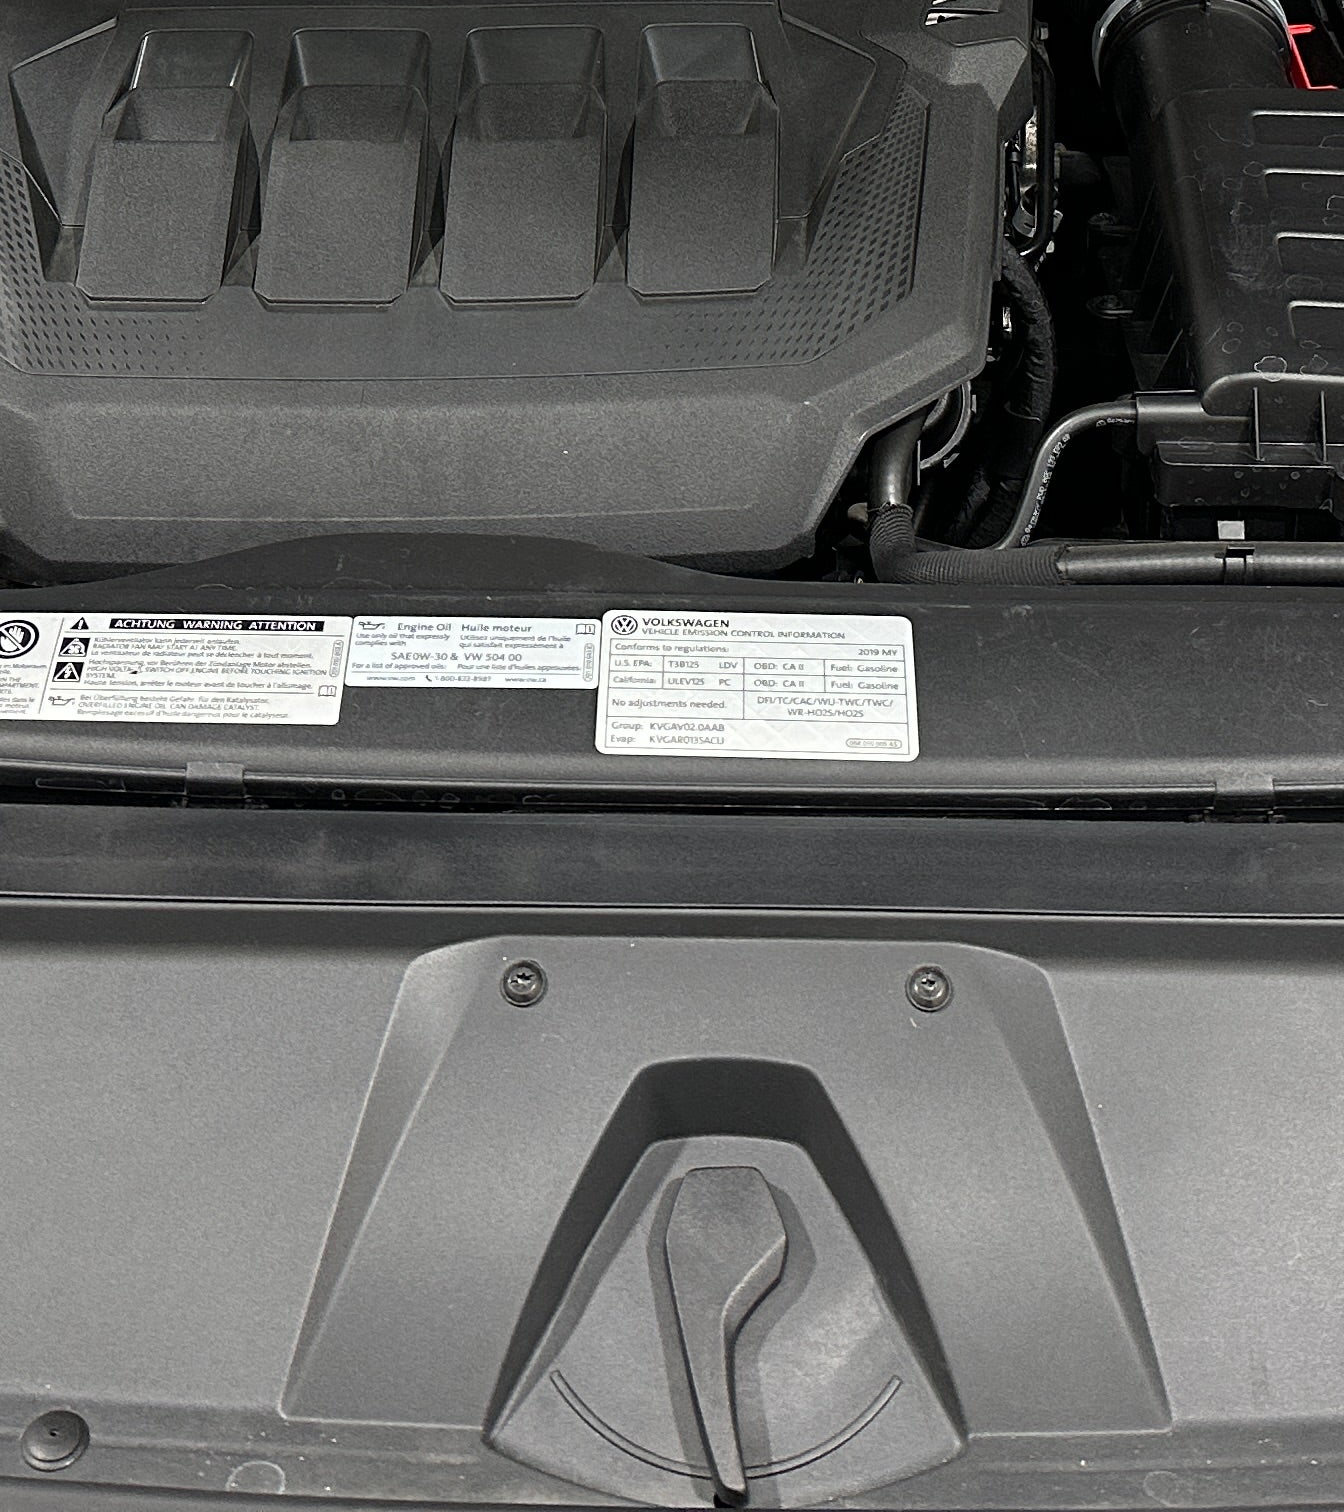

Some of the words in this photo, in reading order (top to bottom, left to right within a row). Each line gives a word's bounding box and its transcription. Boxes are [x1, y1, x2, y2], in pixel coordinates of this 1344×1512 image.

[114, 619, 176, 629] ACHTUNG
[182, 620, 243, 630] WARNING
[249, 621, 317, 631] ATTENTION
[397, 622, 434, 633] Engine
[436, 623, 452, 632] Oil
[461, 623, 490, 632] Huile
[492, 624, 533, 633] moteur
[641, 617, 730, 628] VOLKSWAGEN
[641, 628, 680, 636] VEHICLE
[682, 628, 728, 637] EMISSION
[730, 629, 775, 638] CONTROL
[777, 631, 847, 640] INFORMATION
[614, 642, 660, 652] Conforms
[662, 643, 673, 652] to
[857, 648, 880, 657] 2019
[881, 648, 898, 657] MY
[449, 653, 459, 661] &
[463, 653, 484, 662] VW
[485, 653, 505, 662] 504
[508, 653, 523, 662] 00
[614, 659, 631, 667] U.S.
[633, 659, 653, 667] EPA:
[718, 661, 739, 669] LDV
[753, 662, 779, 671] OBD:
[782, 662, 797, 671] CA
[830, 663, 853, 672] Fuel:
[856, 664, 899, 673] Gasoline
[667, 677, 705, 686] ULEV125
[718, 678, 732, 687] PC
[753, 679, 779, 688] OBD:
[782, 679, 797, 688] CA
[830, 680, 854, 689] Fuel:
[857, 681, 899, 691] Gasoline
[611, 698, 626, 707] No
[627, 698, 688, 709] adjustments
[689, 700, 728, 709] needed.
[611, 721, 644, 731] Group:
